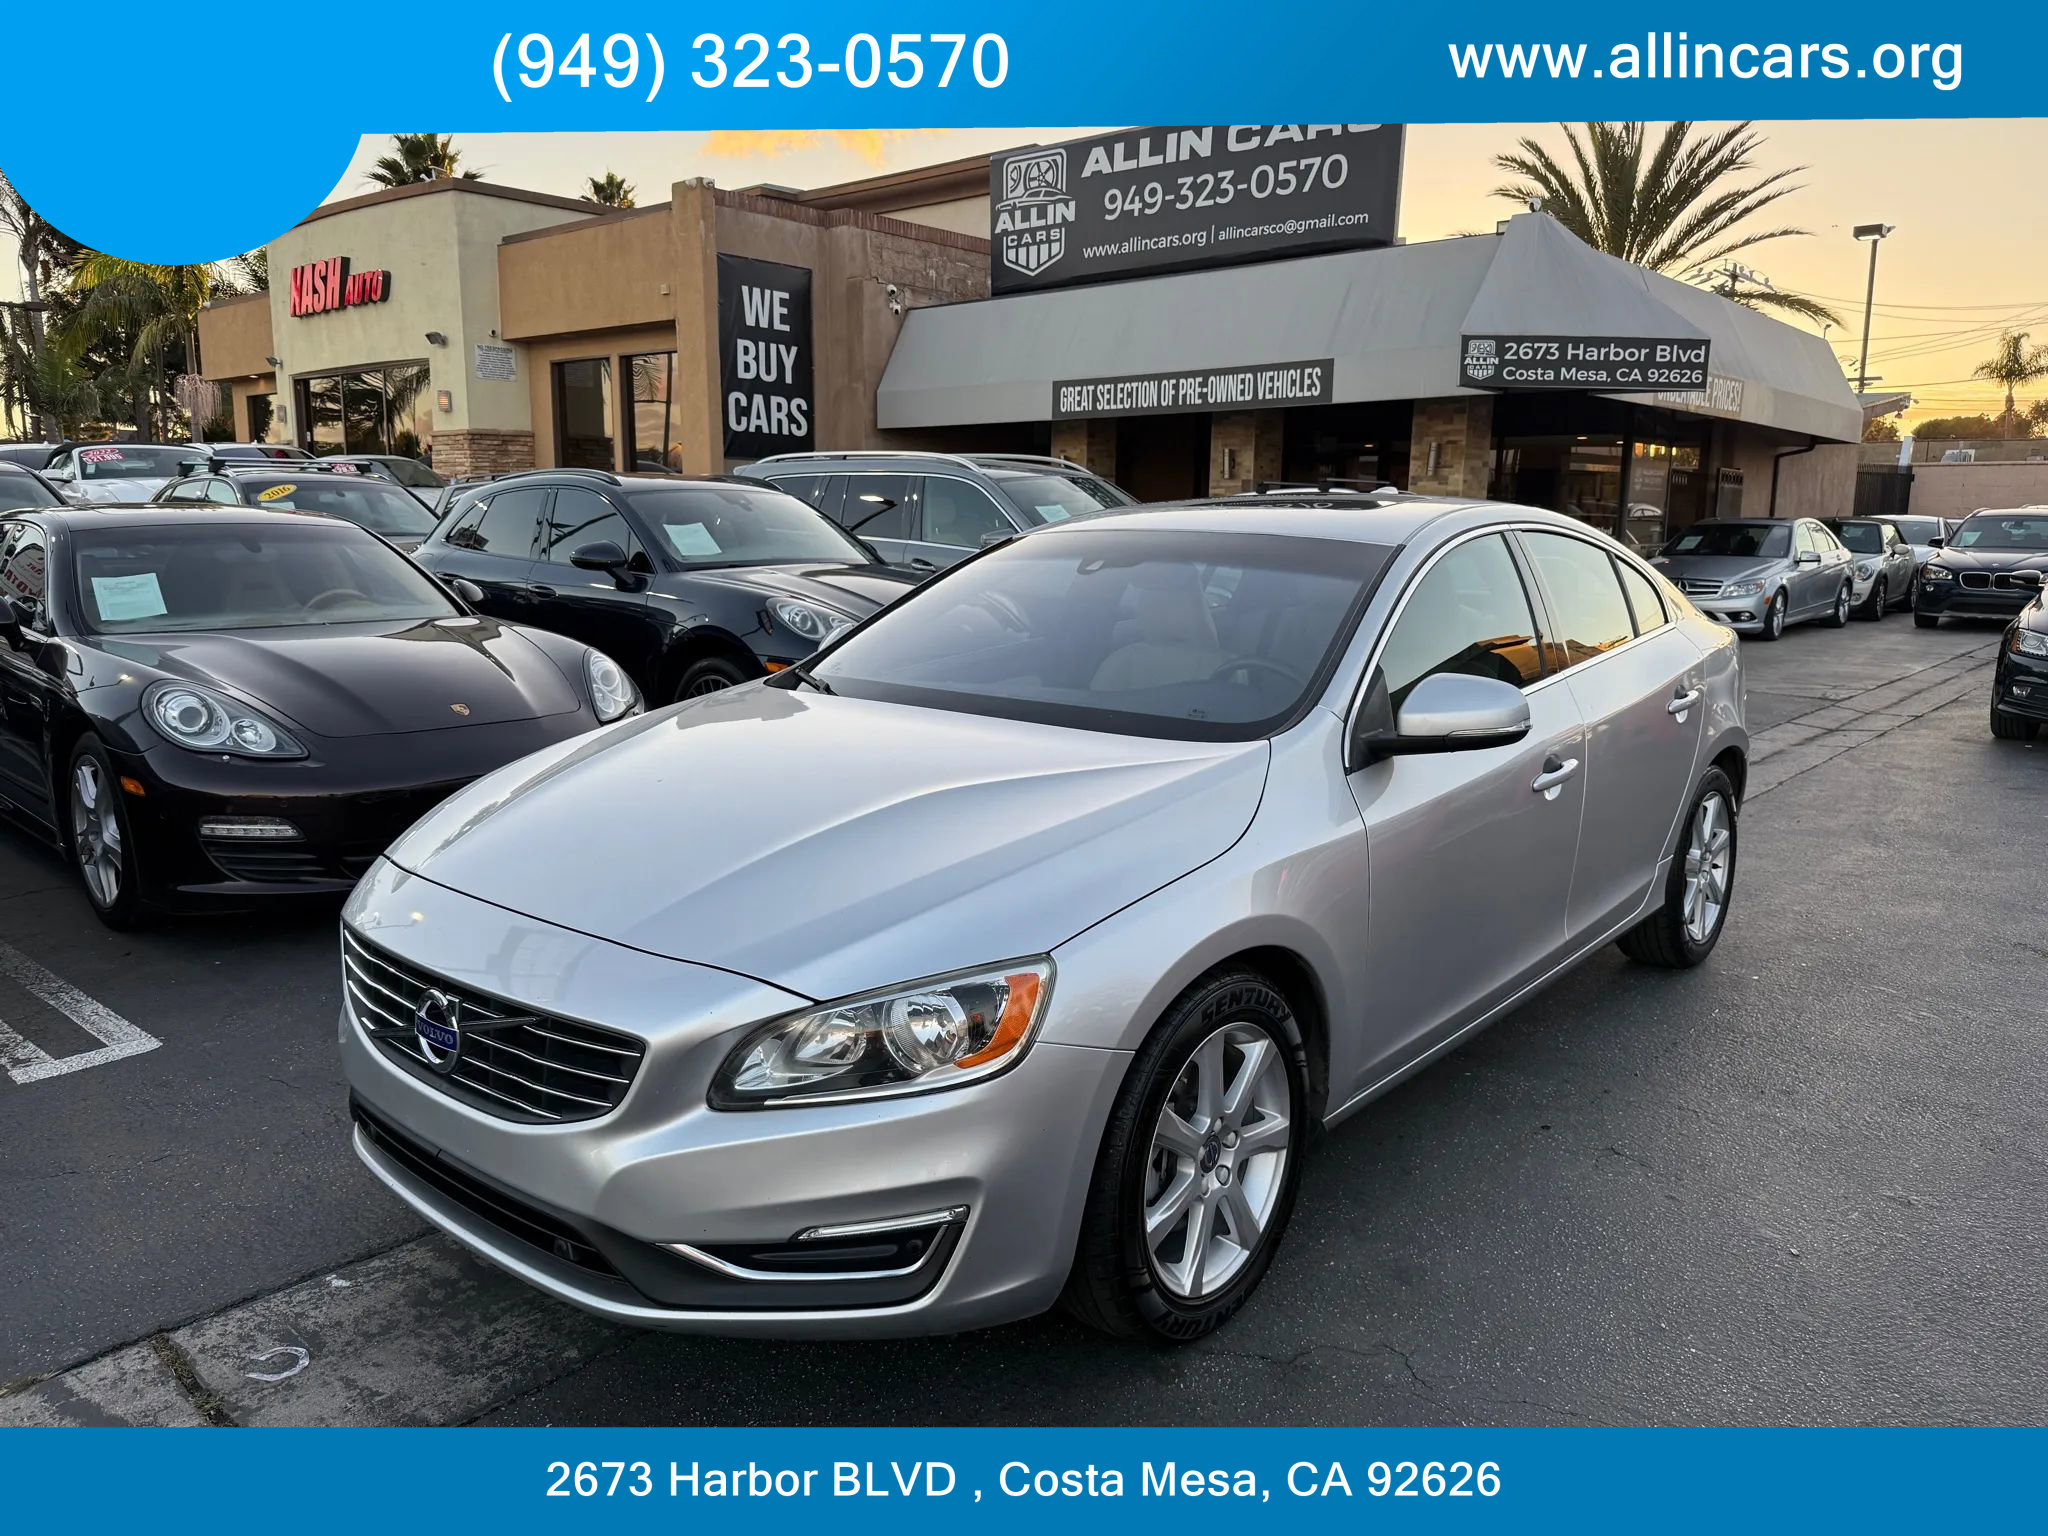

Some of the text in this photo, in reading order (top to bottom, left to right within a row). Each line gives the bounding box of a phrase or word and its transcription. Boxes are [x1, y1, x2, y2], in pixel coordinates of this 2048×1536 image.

[1081, 126, 1213, 178] ALLIN
[1104, 154, 1348, 221] 949-323-0570
[994, 200, 1076, 234] ALLIN
[1007, 228, 1061, 247] CARS
[1083, 212, 1369, 259] www.allincars.org allincarsco@gmail.com
[290, 256, 388, 318] NASH AUTO
[741, 285, 791, 332] WE
[736, 338, 798, 385] BUY
[1463, 357, 1500, 365] ALLIN
[1502, 366, 1703, 383] Costa Mesa, CA 92626
[1504, 342, 1706, 363] 2673 Harbor Blvd
[1060, 367, 1321, 413] GREAT SELECTION OF PRE-OWNED VEHICLES
[728, 391, 808, 437] CARS
[264, 485, 291, 500] 2016
[418, 1021, 454, 1045] VOLVO
